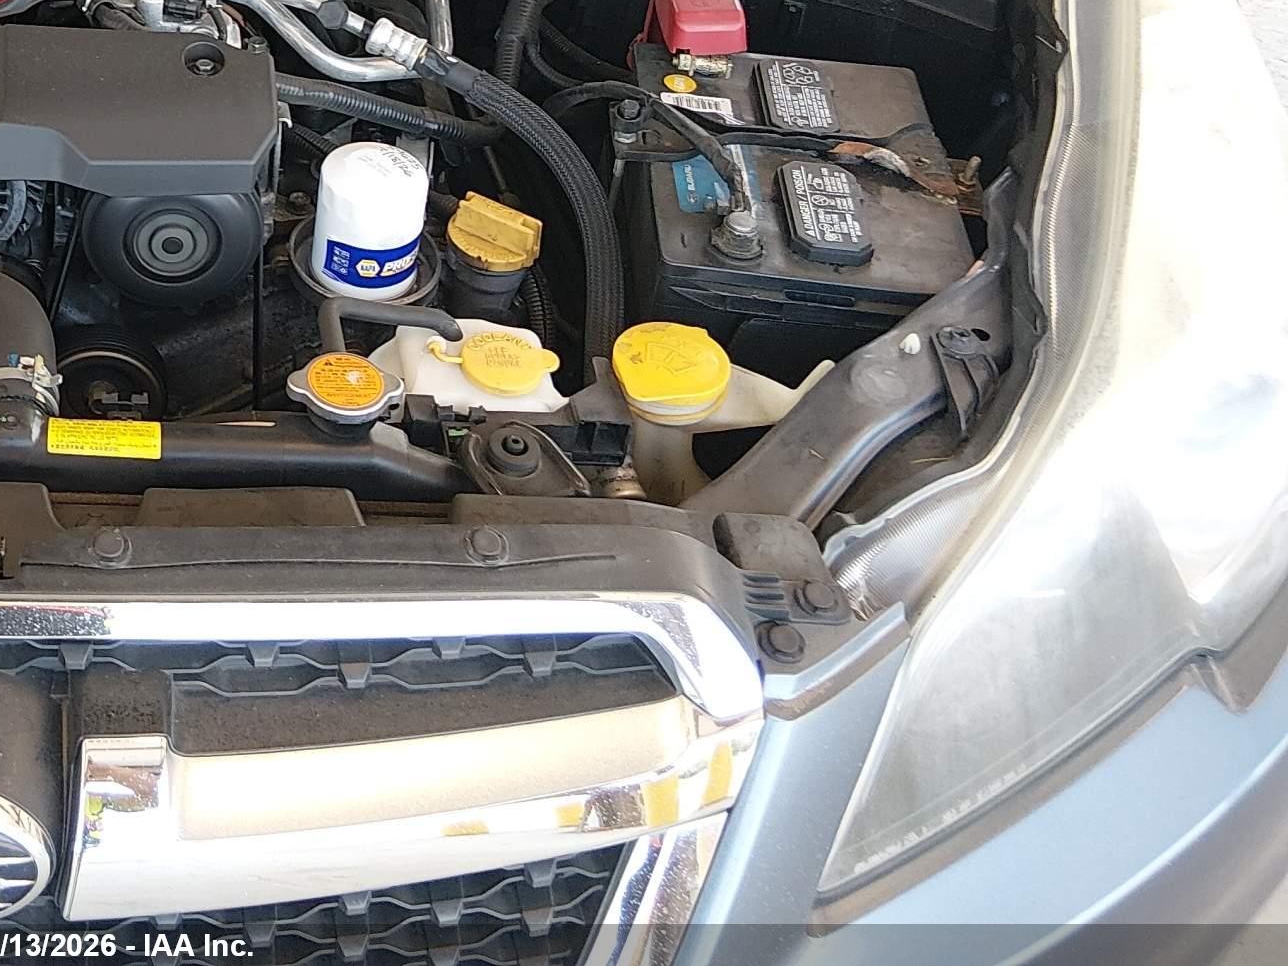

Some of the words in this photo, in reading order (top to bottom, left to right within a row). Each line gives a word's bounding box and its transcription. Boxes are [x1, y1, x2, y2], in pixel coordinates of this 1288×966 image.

[685, 164, 696, 191] SUBARU
[791, 169, 806, 195] POISON
[798, 200, 815, 230] DANGER
[467, 331, 532, 351] COOLANT
